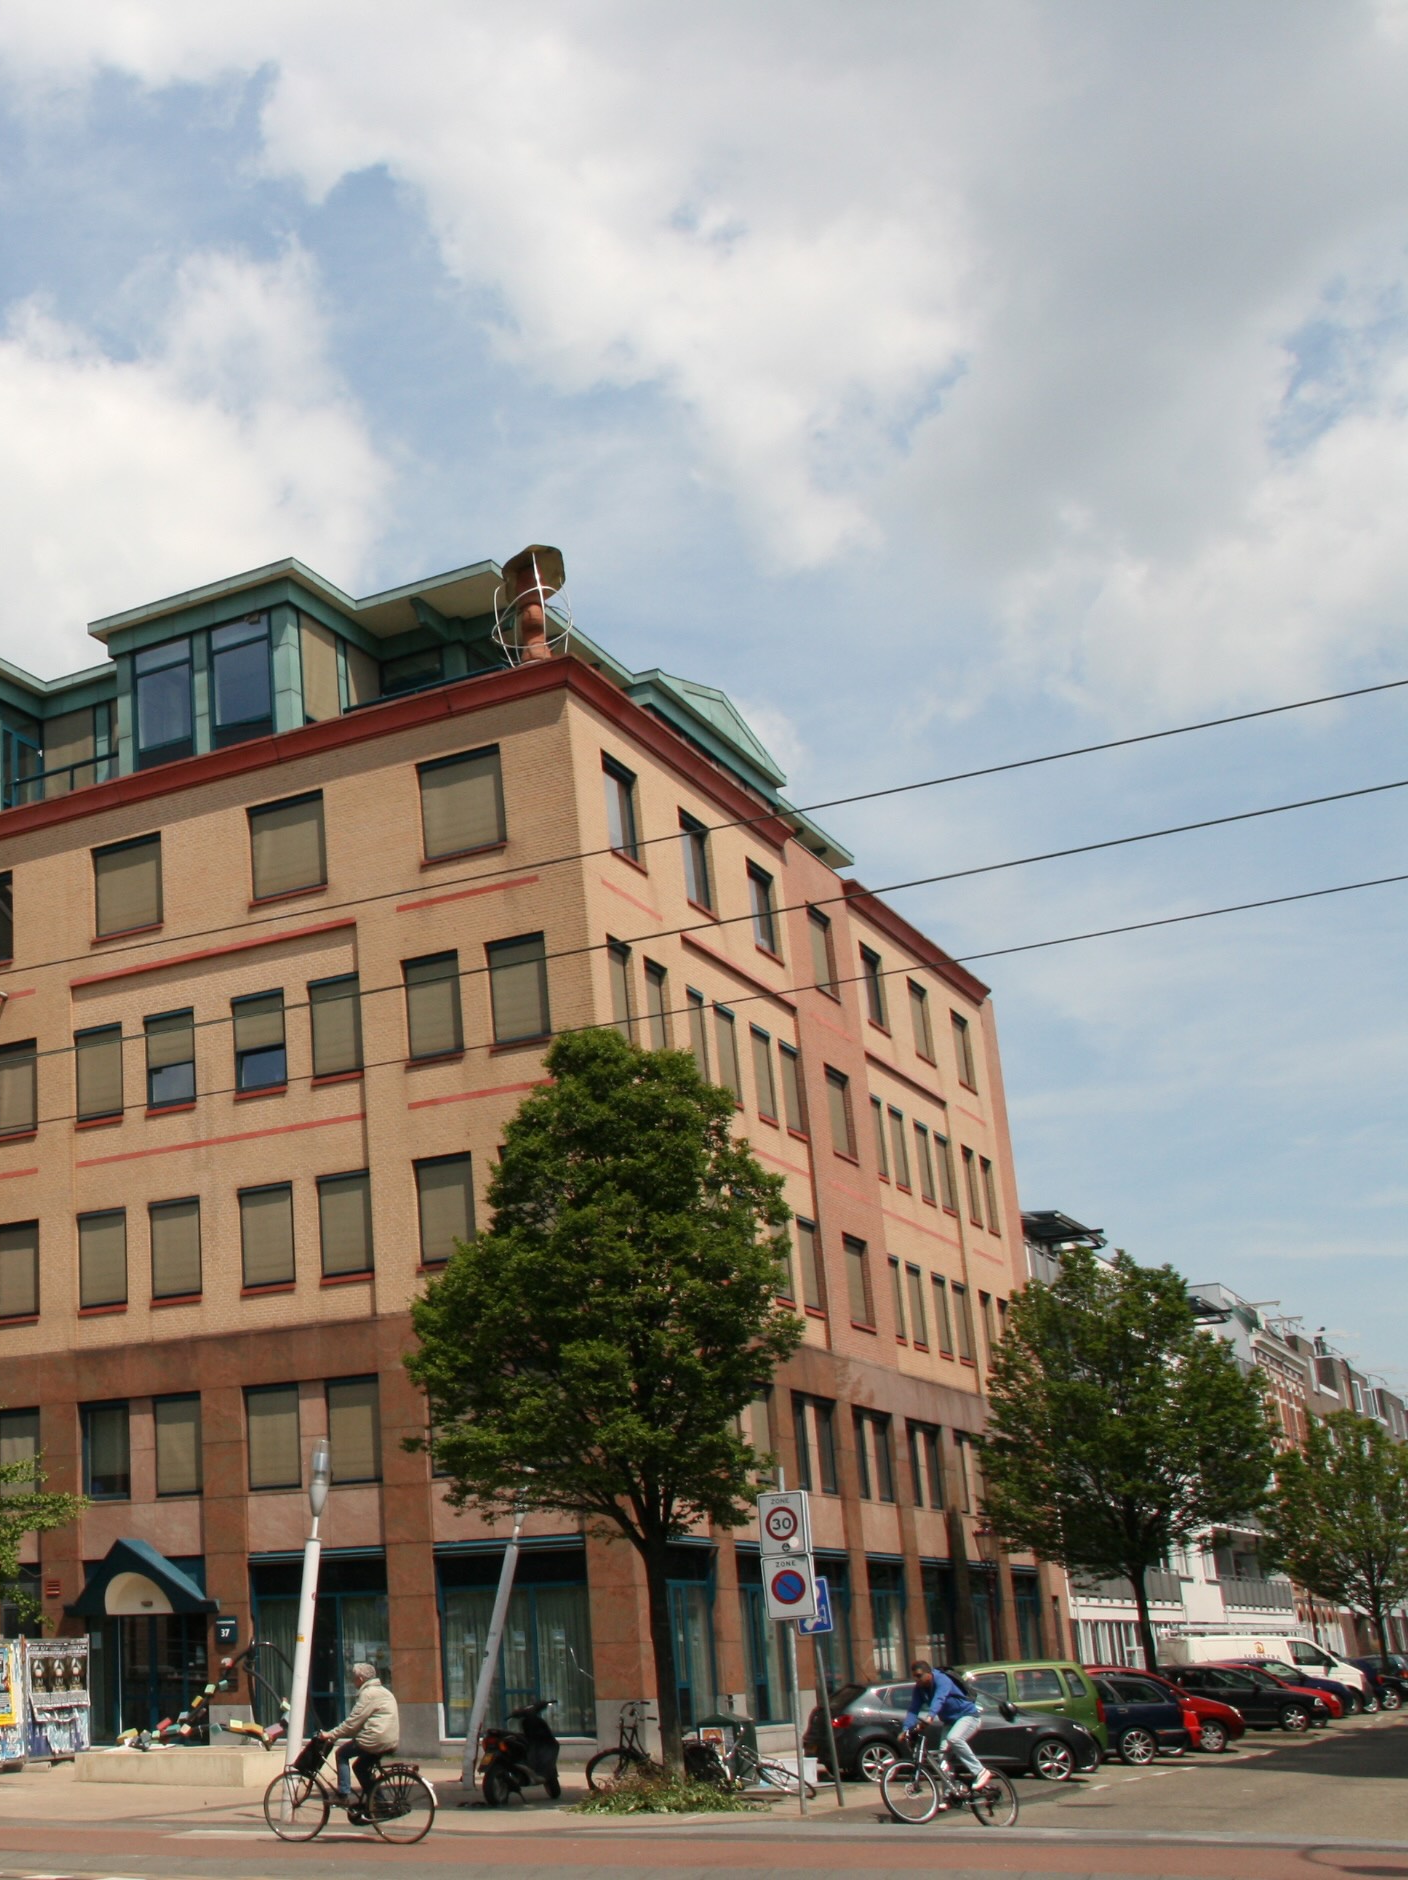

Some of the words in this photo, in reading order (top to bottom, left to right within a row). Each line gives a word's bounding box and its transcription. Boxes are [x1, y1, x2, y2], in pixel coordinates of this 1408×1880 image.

[770, 1497, 790, 1505] ZONE
[772, 1517, 792, 1530] 30
[776, 1560, 796, 1568] ZONE
[220, 1628, 231, 1637] 37
